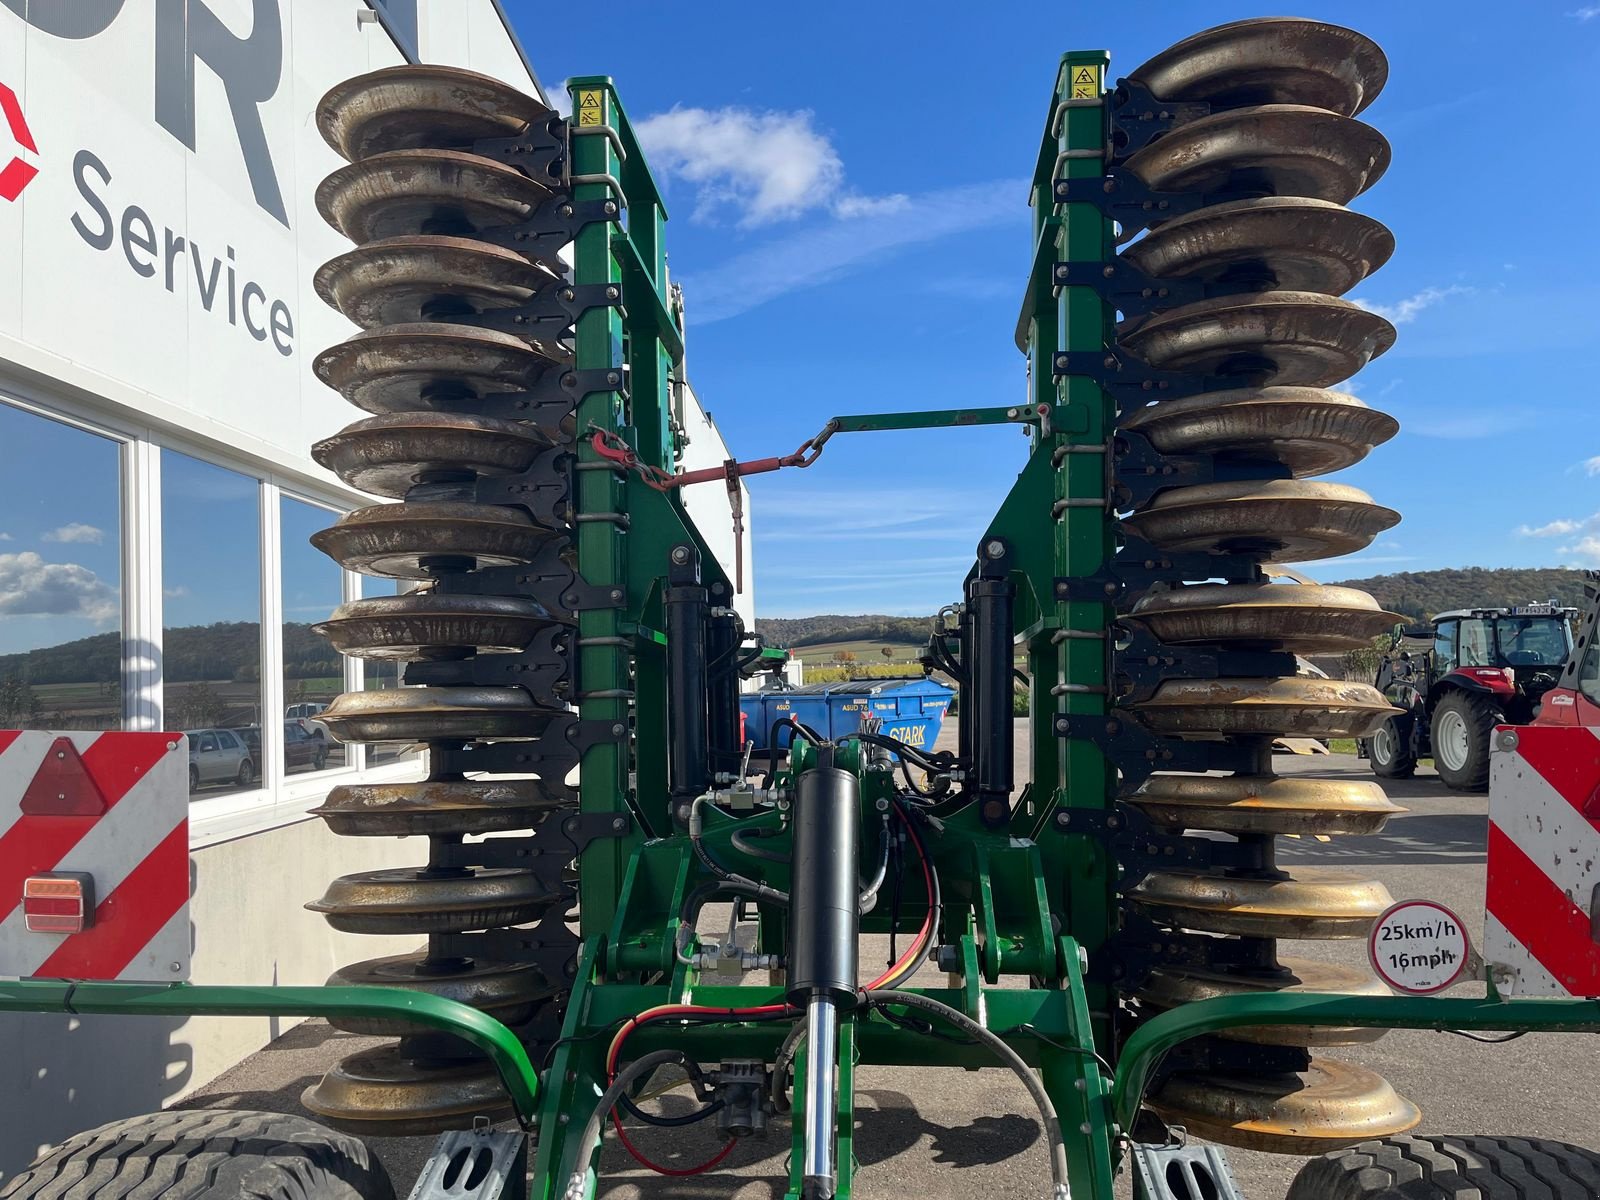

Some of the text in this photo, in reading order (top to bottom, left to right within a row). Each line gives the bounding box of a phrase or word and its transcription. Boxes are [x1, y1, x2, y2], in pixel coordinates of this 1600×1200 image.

[70, 149, 294, 357] Service
[1381, 921, 1456, 941] 25km/h
[1389, 949, 1453, 970] 16mph
